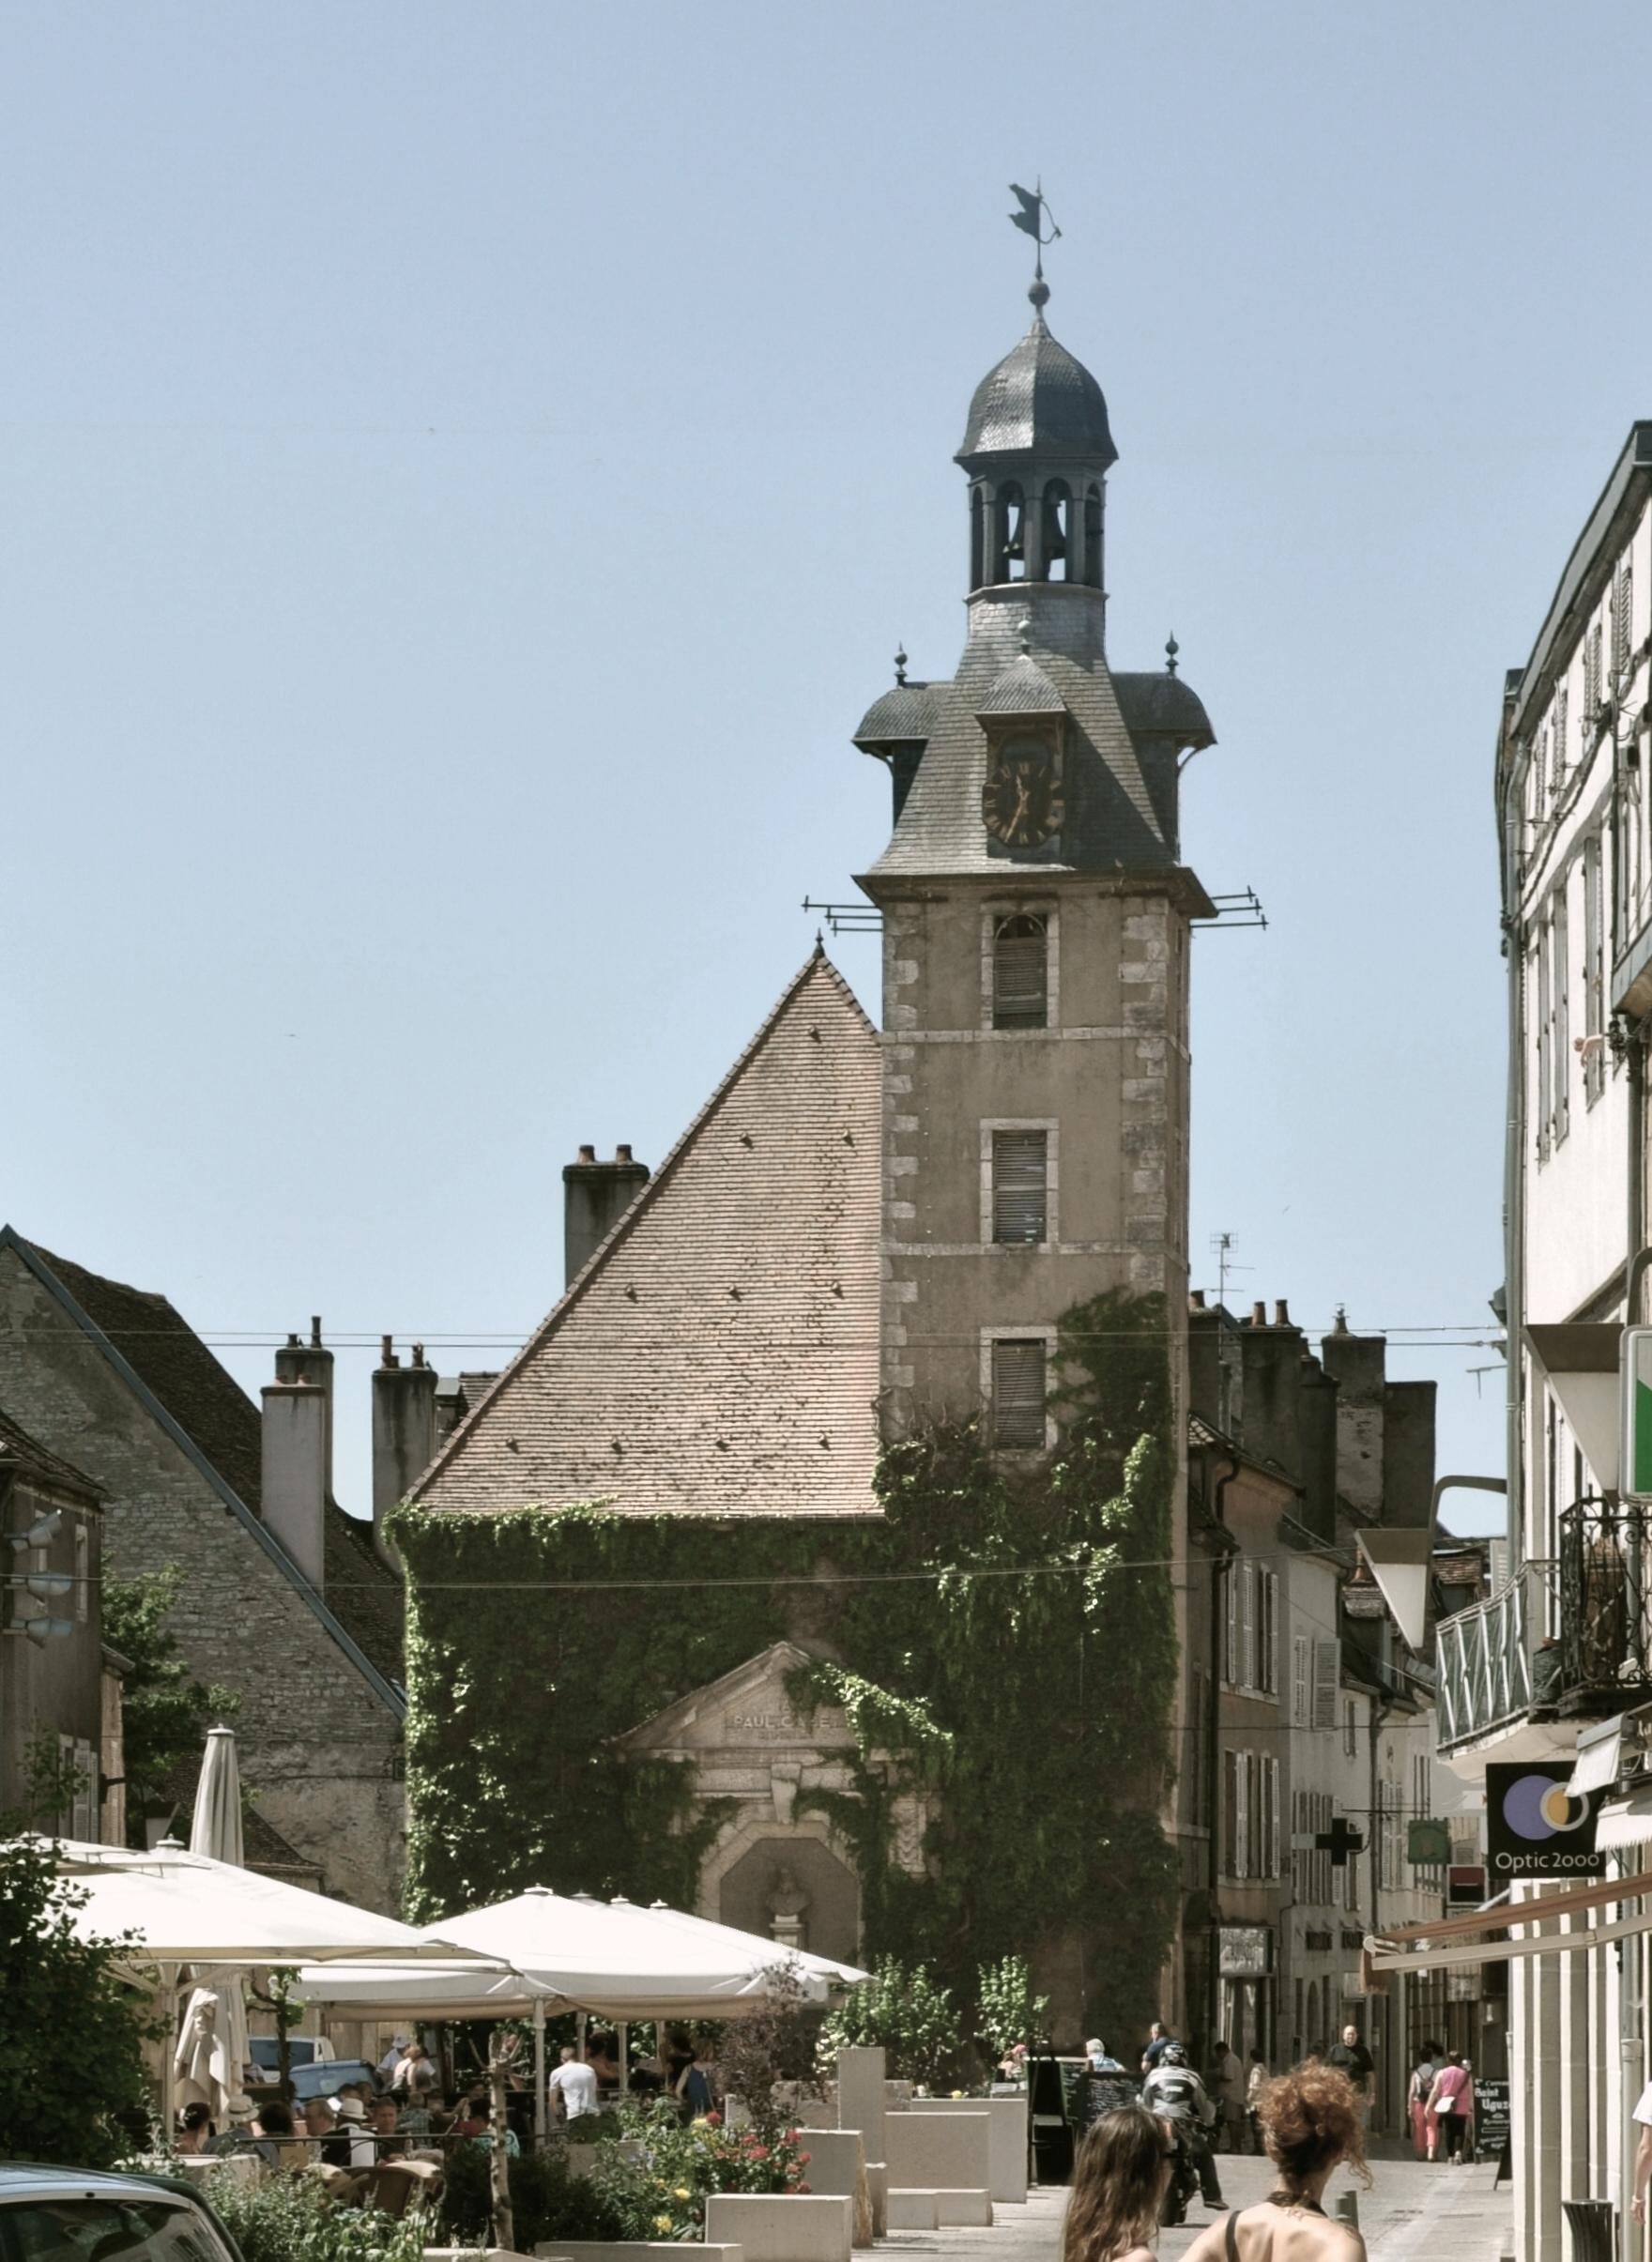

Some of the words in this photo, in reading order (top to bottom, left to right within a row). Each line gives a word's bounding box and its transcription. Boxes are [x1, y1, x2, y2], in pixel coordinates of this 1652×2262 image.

[734, 1715, 776, 1728] PAUL
[1495, 1851, 1549, 1873] Optic
[1552, 1852, 1599, 1868] 2000
